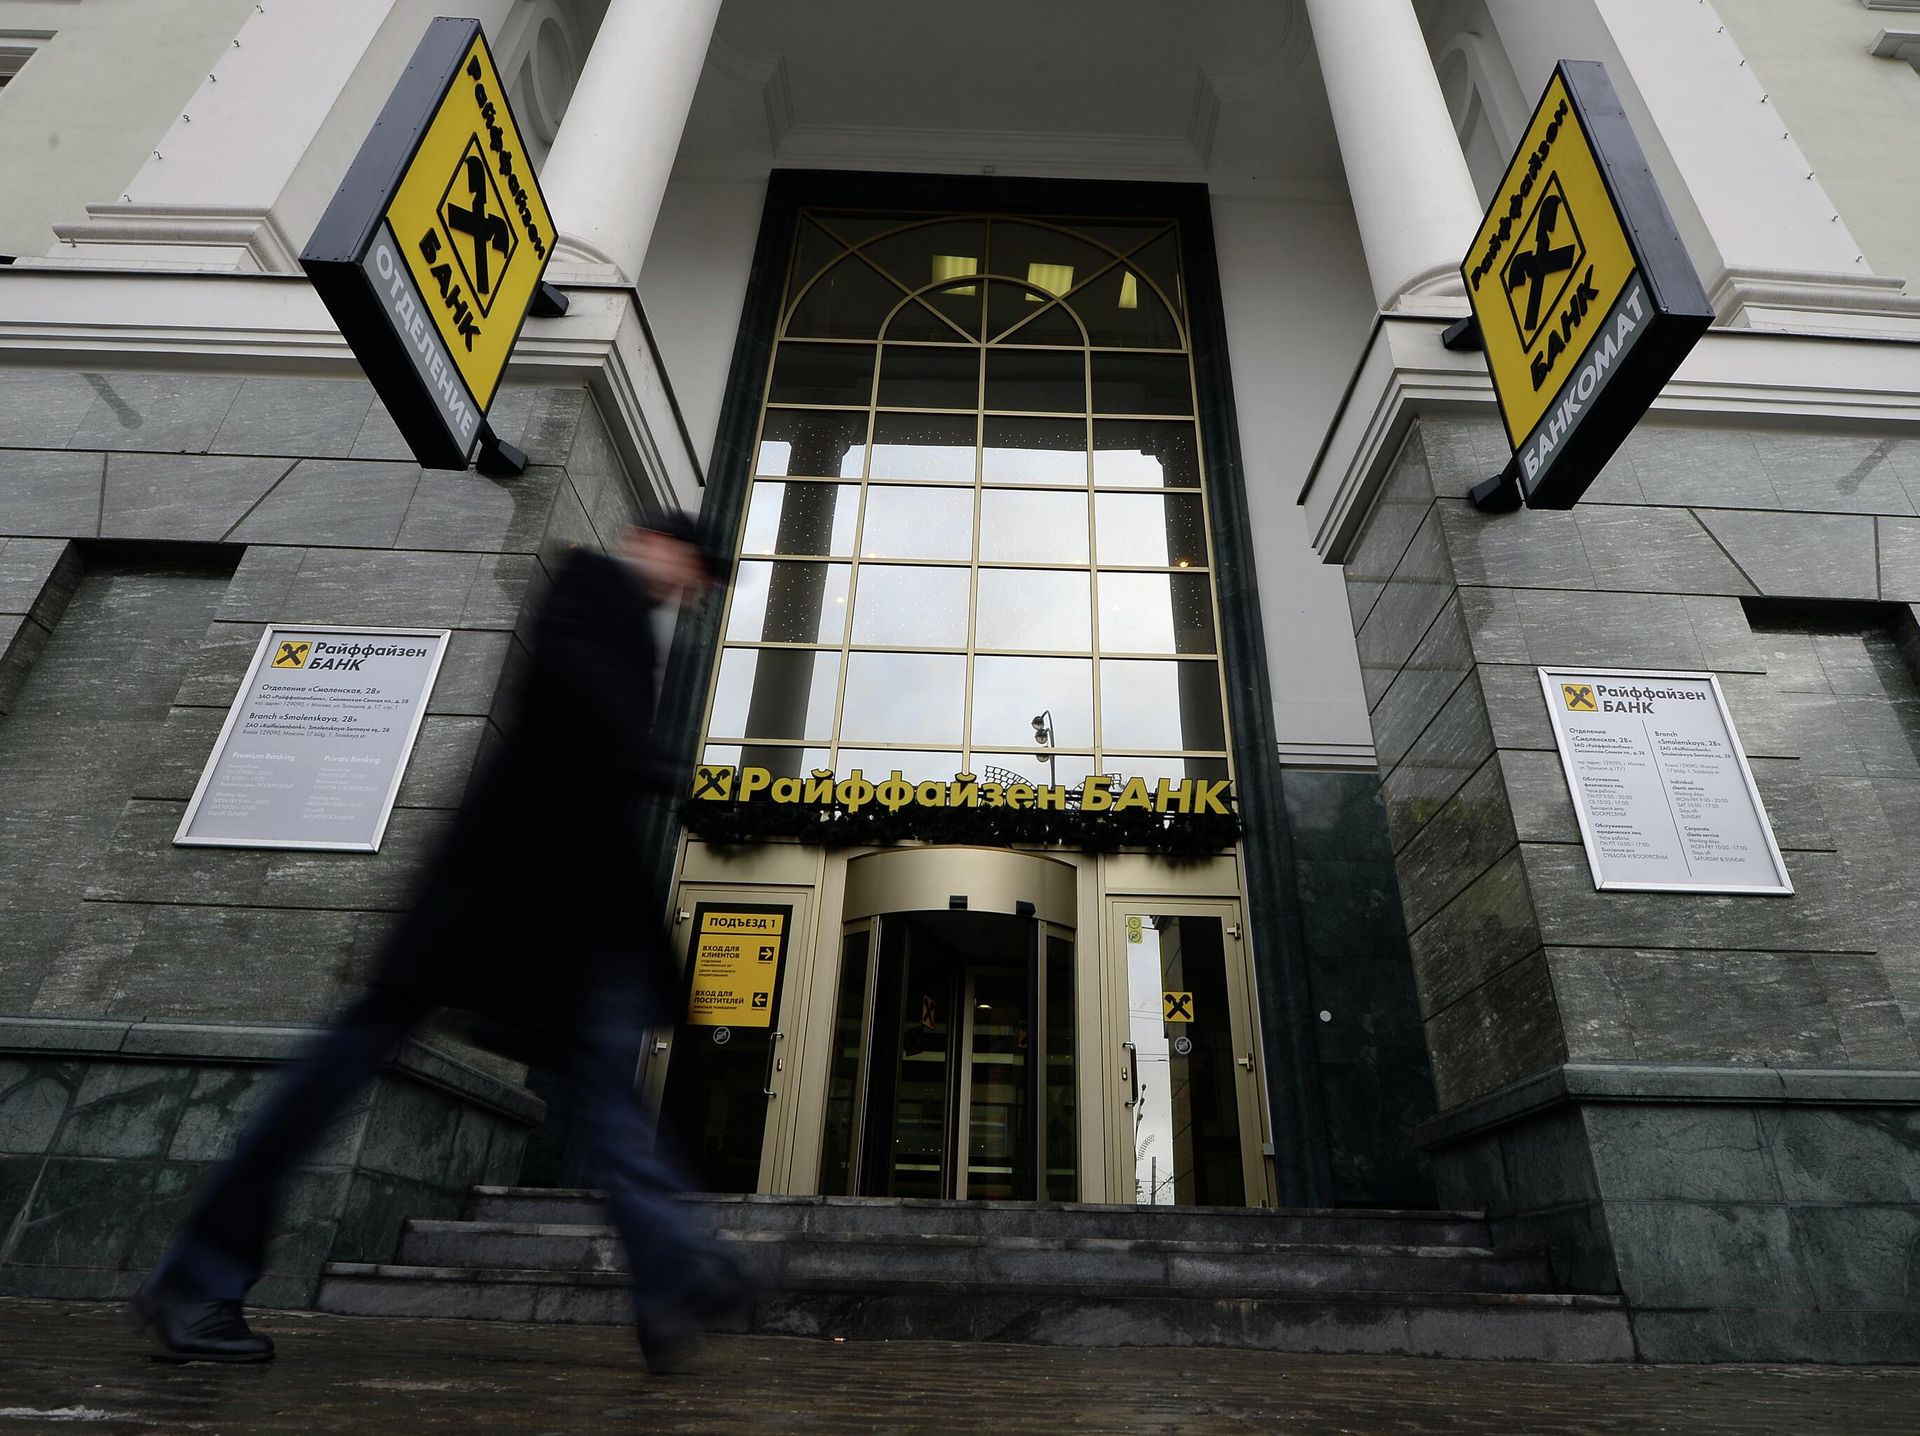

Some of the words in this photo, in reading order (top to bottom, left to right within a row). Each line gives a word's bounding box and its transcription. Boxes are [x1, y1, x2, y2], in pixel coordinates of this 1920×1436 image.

[466, 54, 546, 260] Райффайзен
[1470, 99, 1569, 291] Райффайзен
[419, 227, 481, 352] БАНК
[1530, 265, 1599, 392] БАНК
[376, 245, 473, 437] ОТДЕЛЕНИЕ
[1524, 287, 1641, 481] БАНКОМАТ
[314, 642, 427, 659] Райффайзен
[309, 657, 365, 669] БАНК
[260, 683, 307, 692] Отделение
[1598, 685, 1706, 701] Райффайзен
[1603, 700, 1655, 712] БАНК
[249, 711, 278, 719] Branch
[231, 751, 265, 759] Premium
[264, 752, 296, 761] Banking
[322, 754, 350, 762] Private
[349, 755, 382, 764] Banking
[739, 766, 1067, 813] Райффайзен
[1079, 777, 1234, 814] БАНК
[709, 917, 767, 928] ПОДЪЕЗД
[770, 919, 775, 927] 1
